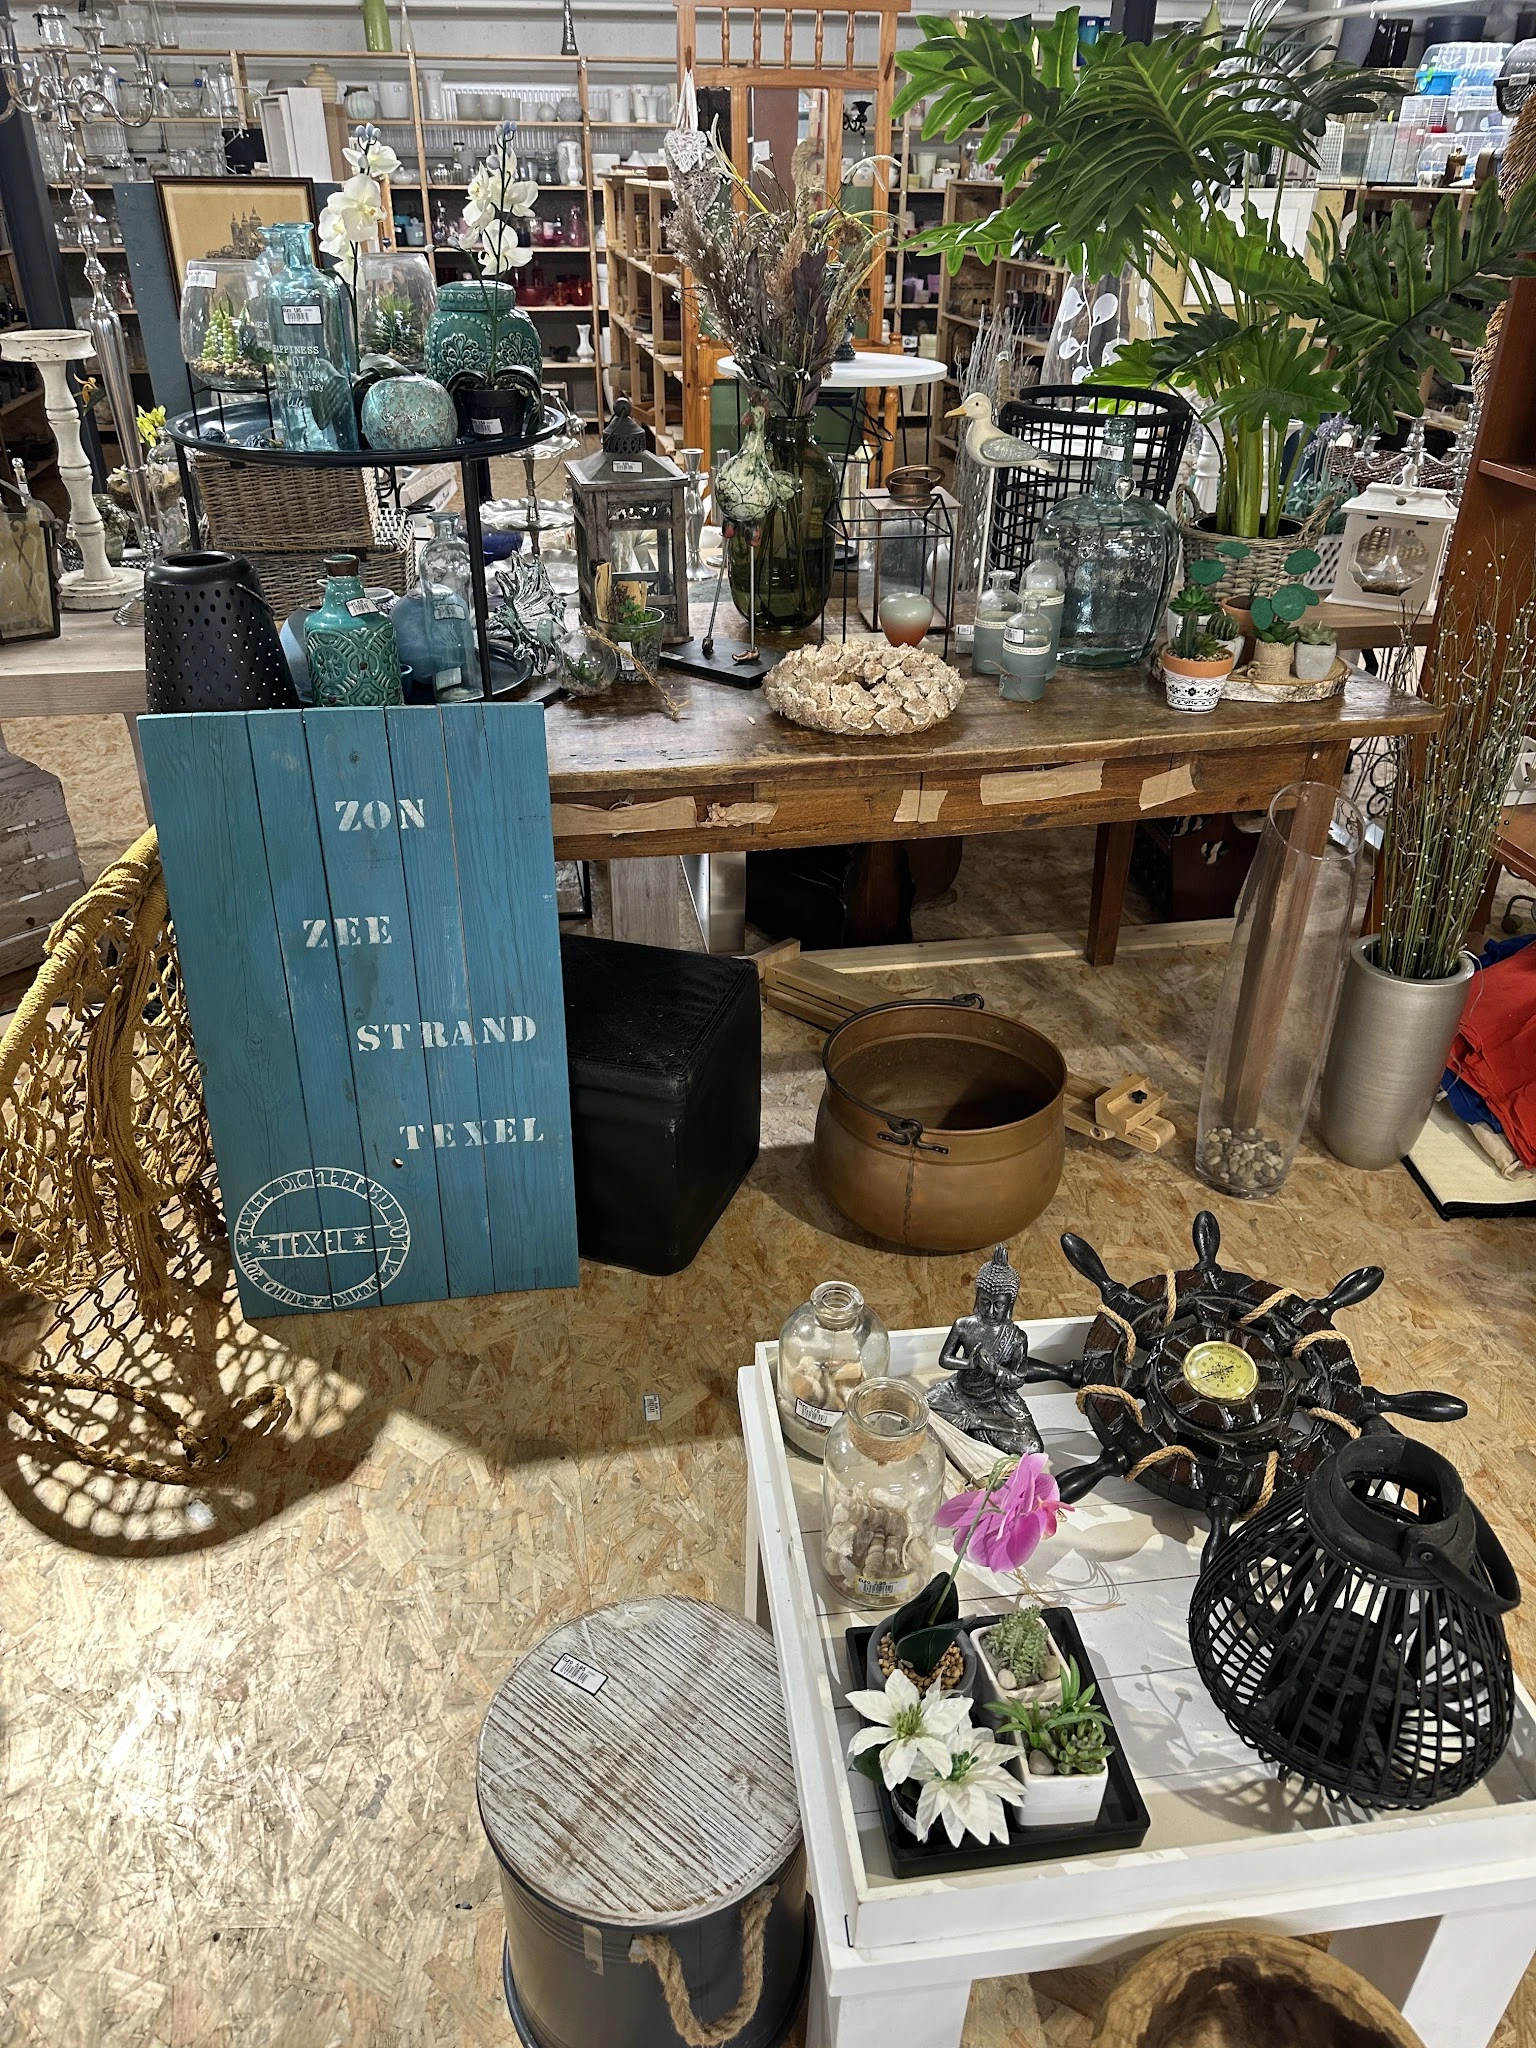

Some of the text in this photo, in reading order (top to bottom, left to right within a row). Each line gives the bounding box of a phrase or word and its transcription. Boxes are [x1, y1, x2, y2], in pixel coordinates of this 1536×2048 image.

[334, 798, 426, 832] ZON
[302, 915, 393, 948] ZEE
[356, 1015, 537, 1051] STRAND
[399, 1117, 544, 1151] TEXEL
[238, 1191, 274, 1232] TEXEL
[269, 1229, 348, 1257] TEXEL
